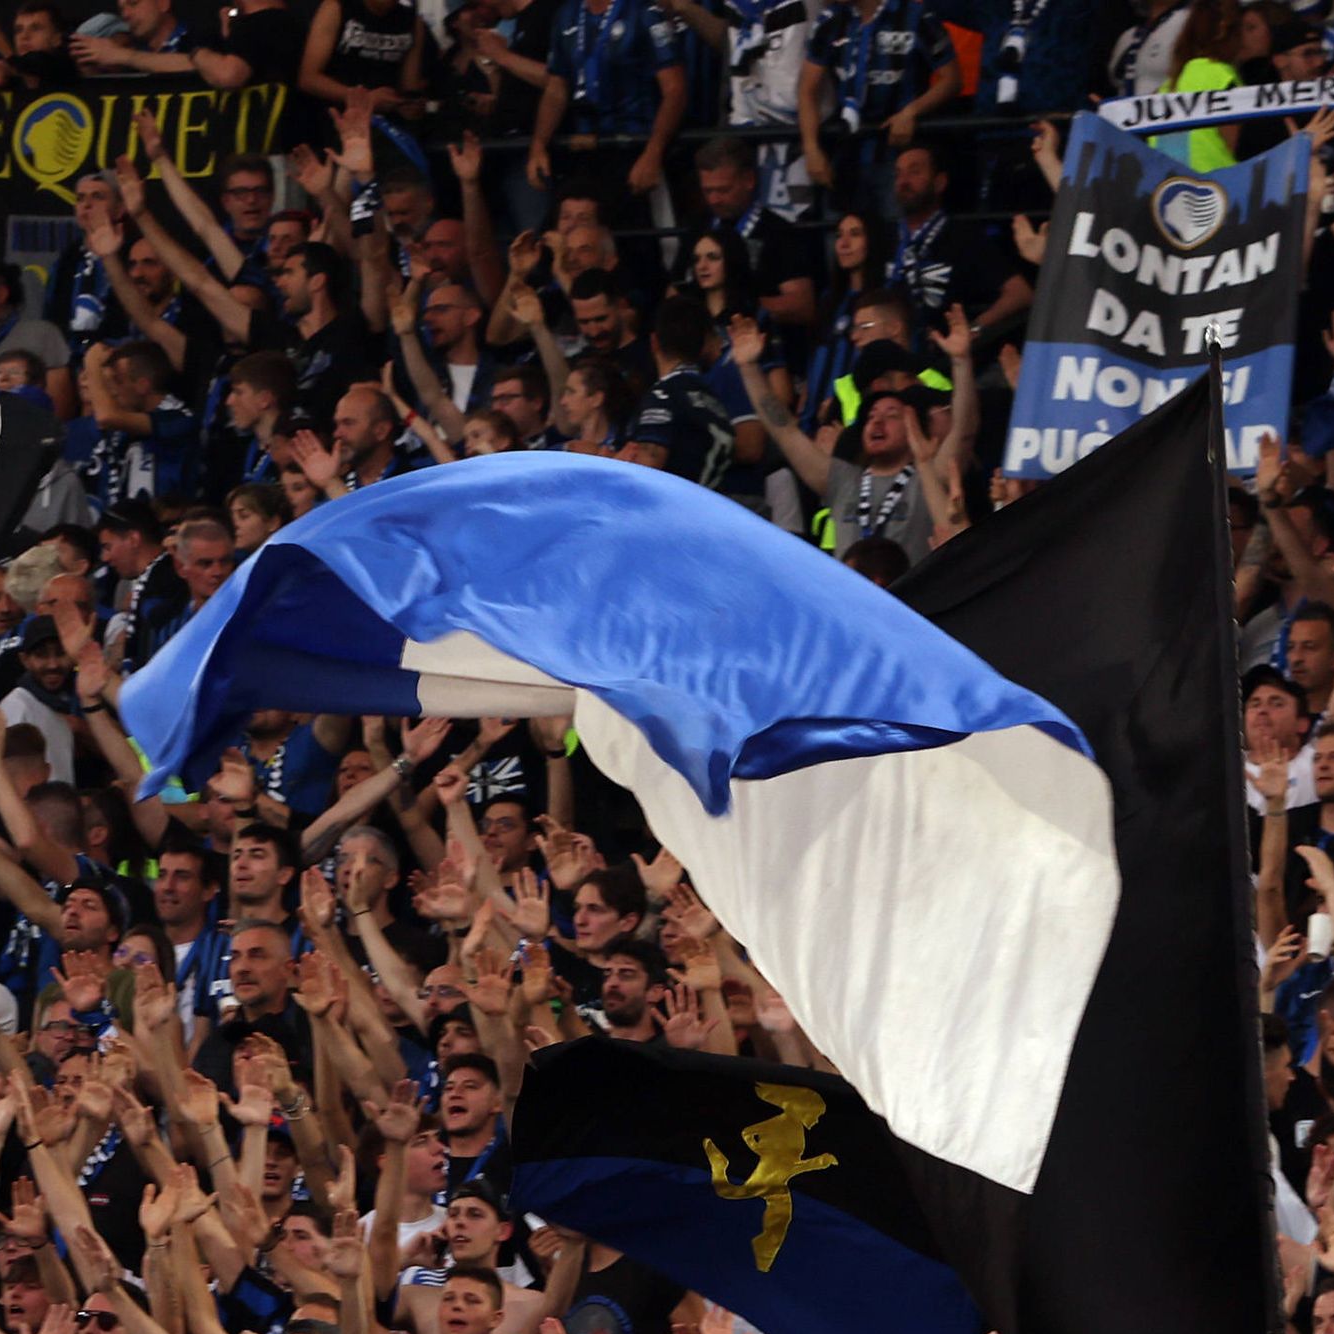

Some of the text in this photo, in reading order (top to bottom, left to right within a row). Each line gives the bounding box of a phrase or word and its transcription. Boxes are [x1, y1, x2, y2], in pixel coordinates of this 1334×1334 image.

[1123, 88, 1233, 128] JUVE
[1069, 211, 1281, 296] LONTAN
[1087, 288, 1246, 357] DA TE
